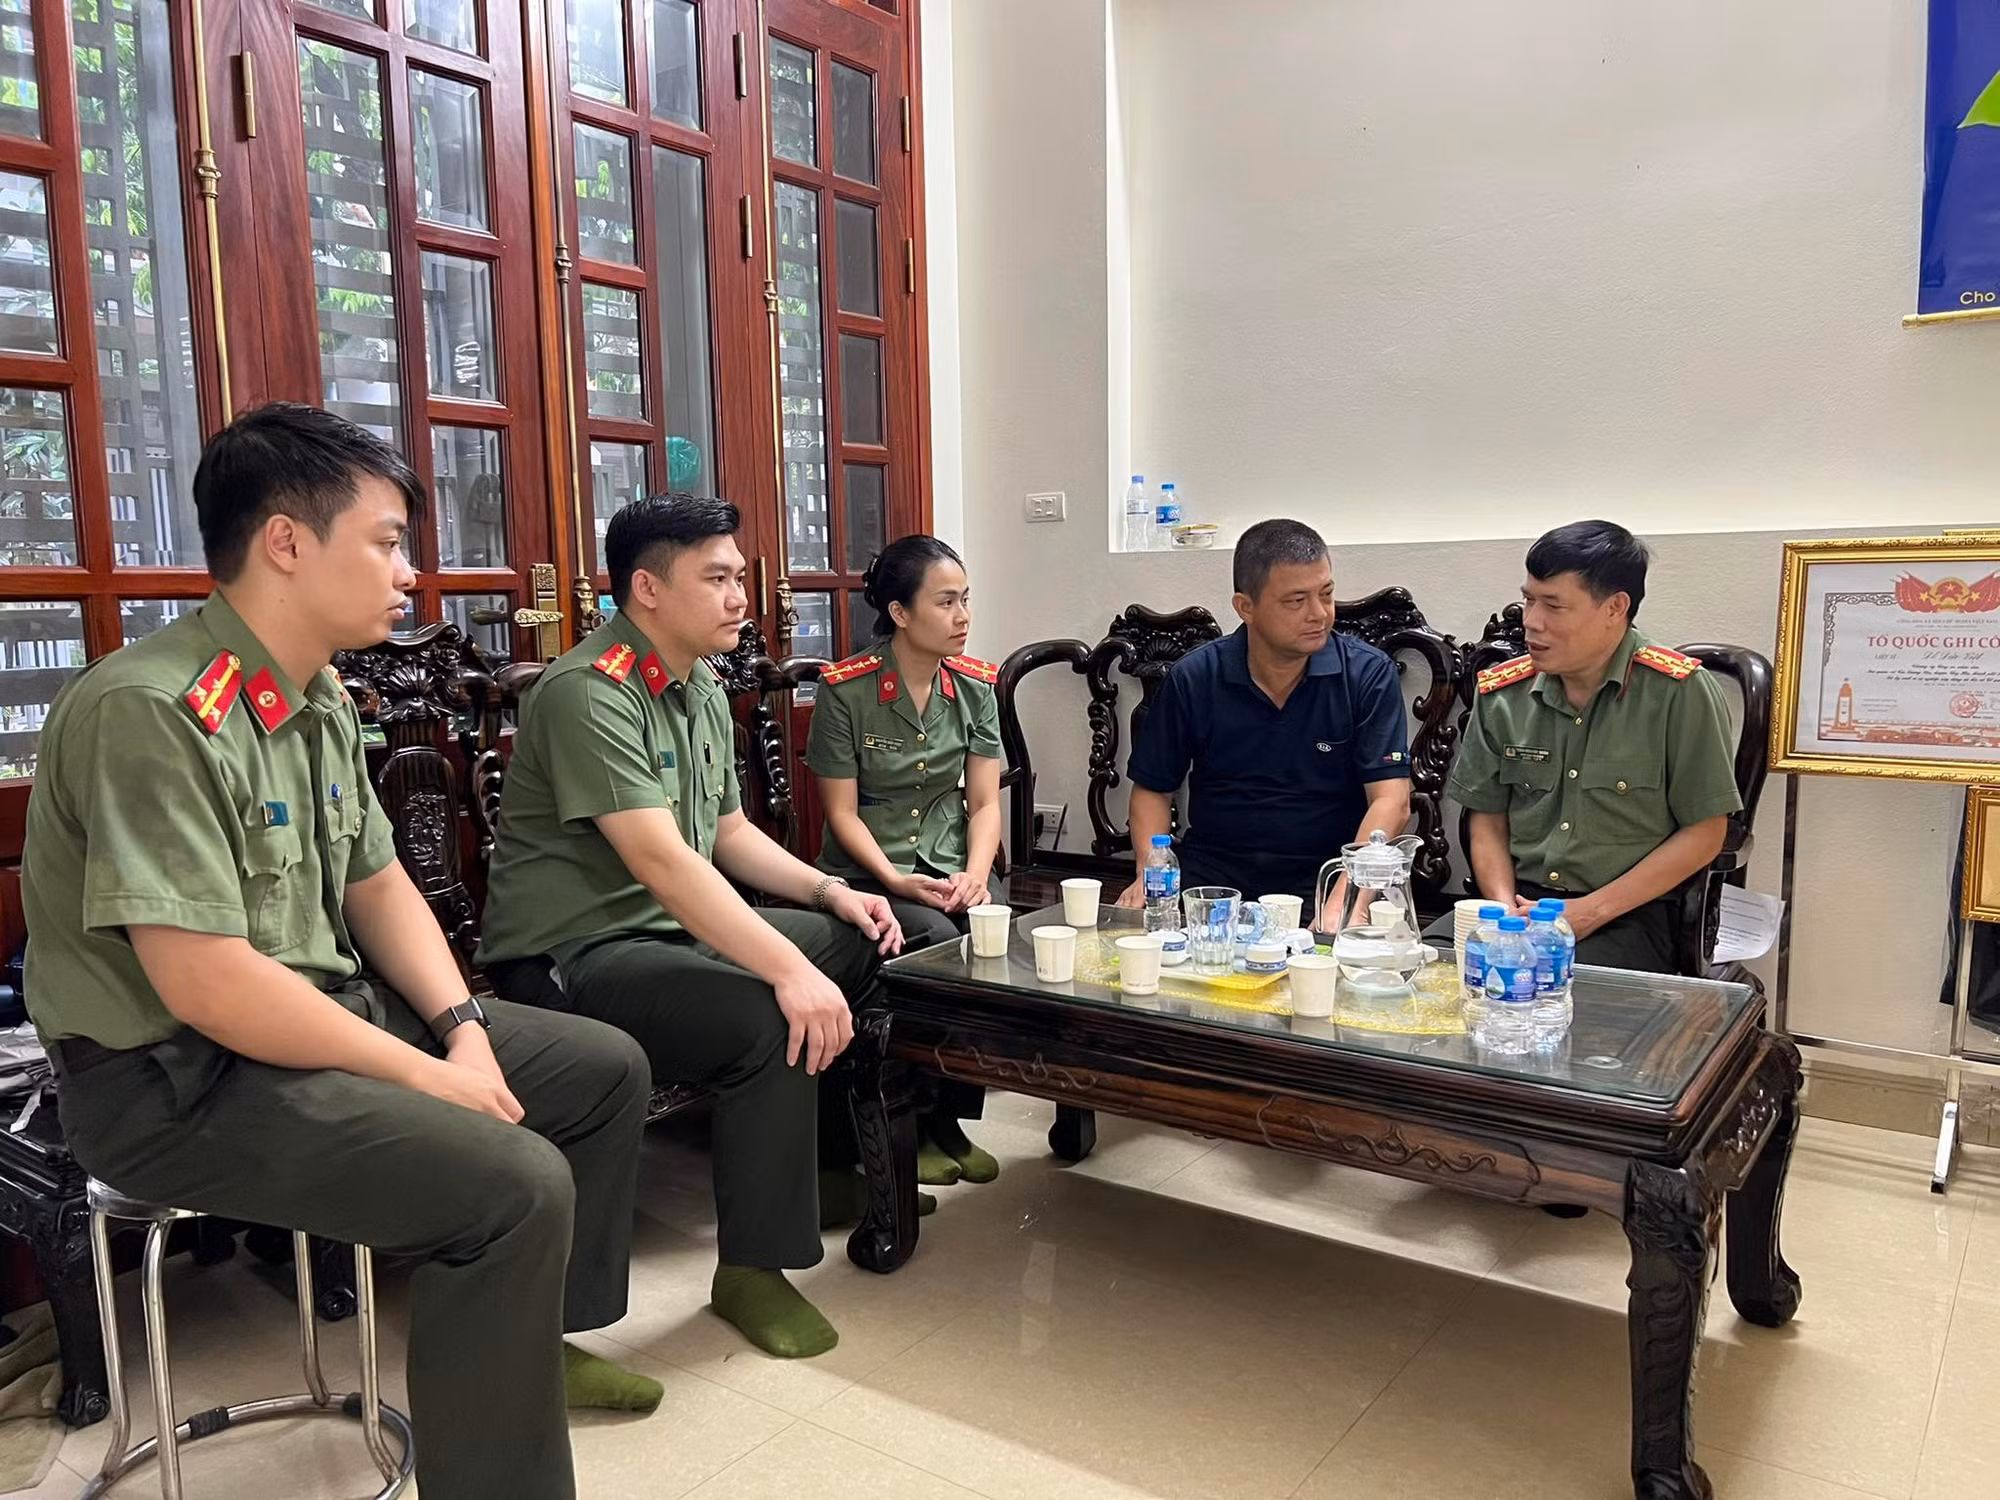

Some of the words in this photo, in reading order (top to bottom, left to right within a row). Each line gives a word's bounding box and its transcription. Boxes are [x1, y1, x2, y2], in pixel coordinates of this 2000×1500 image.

[1960, 291, 1996, 304] Cho
[1892, 634, 1940, 650] QUỐC
[1943, 636, 1976, 648] GHI
